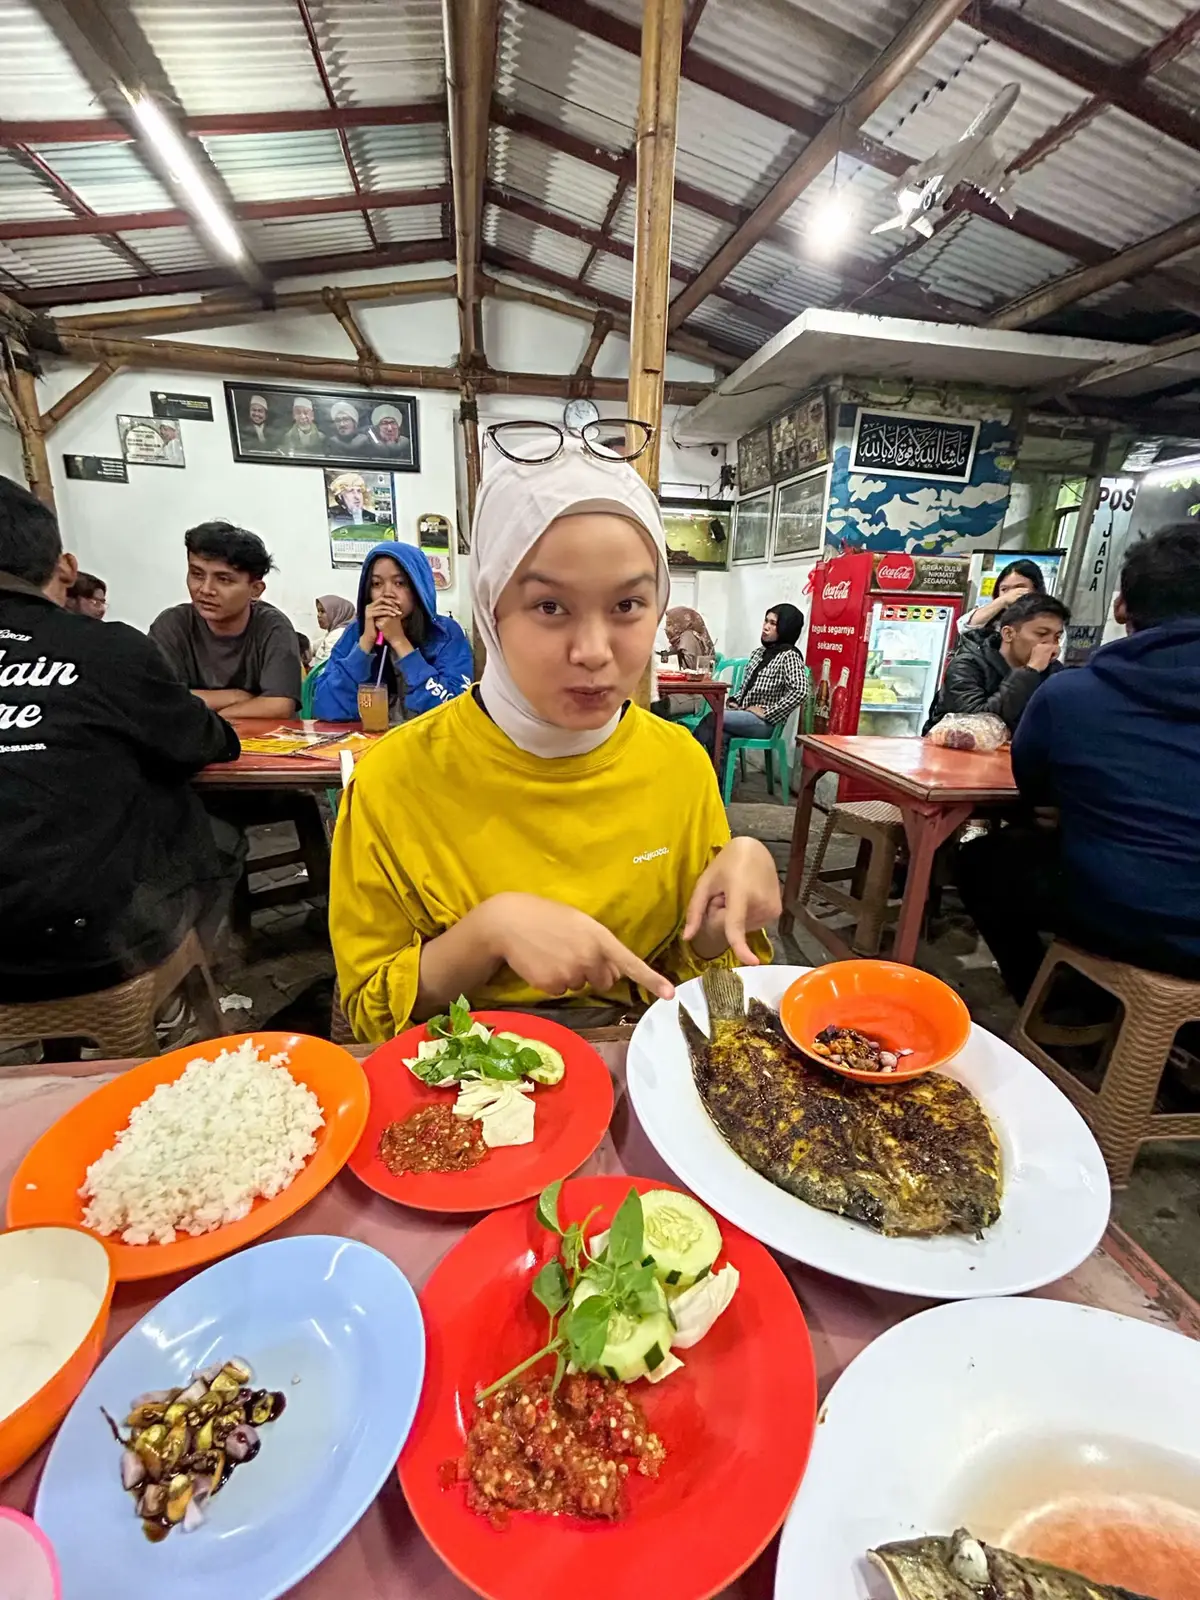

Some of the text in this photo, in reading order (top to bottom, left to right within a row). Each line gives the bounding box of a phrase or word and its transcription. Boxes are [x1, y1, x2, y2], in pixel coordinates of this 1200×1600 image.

[1097, 486, 1136, 512] POS
[1089, 523, 1113, 592] JAGA
[879, 565, 913, 579] Coca-Cola
[822, 580, 851, 600] Coca-Cola
